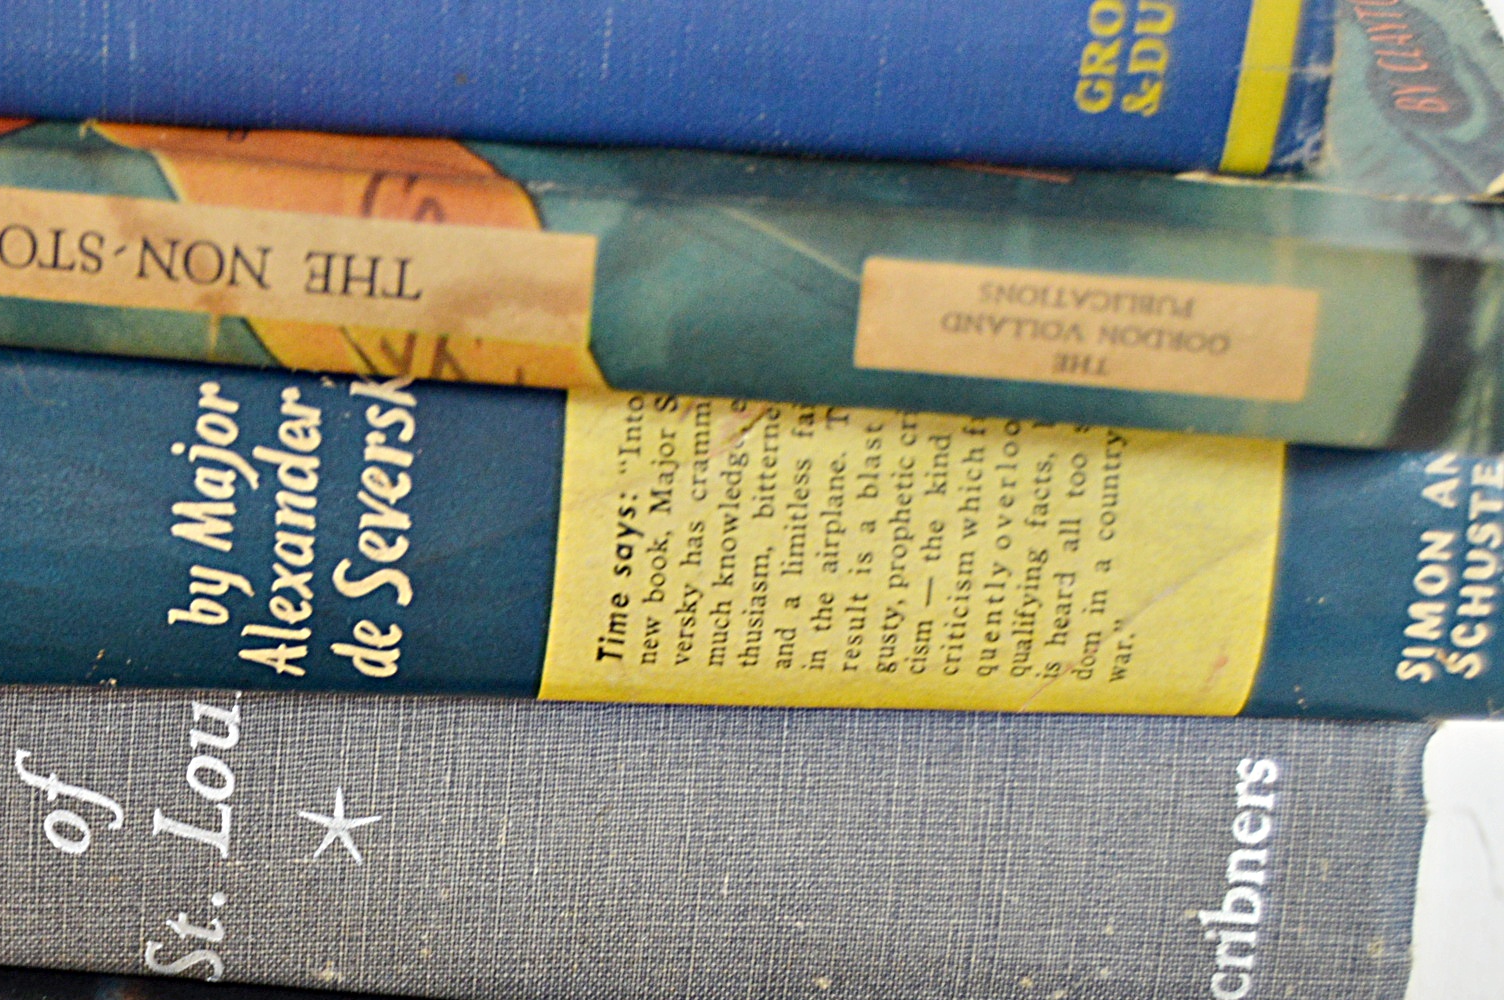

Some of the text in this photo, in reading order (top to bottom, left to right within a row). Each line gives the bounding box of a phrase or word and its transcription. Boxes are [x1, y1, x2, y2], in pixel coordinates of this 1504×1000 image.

[305, 250, 422, 301] THE
[979, 281, 1195, 319] PUBLICATIONS
[940, 311, 1232, 356] GORDON VOLLAND
[1053, 352, 1107, 377] THE
[649, 429, 679, 515] Major
[924, 432, 952, 496] kind
[1024, 451, 1056, 529] facts,
[1066, 452, 1088, 500] too
[167, 381, 260, 625] by Major
[238, 387, 322, 676] Alexander
[596, 396, 644, 662] Time says: “Into
[781, 458, 812, 576] limitless
[816, 452, 848, 574] airplane.
[888, 454, 915, 590] prophetic
[1059, 517, 1082, 553] all
[643, 530, 672, 603] book,
[680, 520, 705, 567] has
[843, 422, 884, 672] result is a blast
[920, 519, 945, 562] the
[940, 549, 975, 676] criticism
[958, 446, 986, 539] which
[976, 420, 1021, 677] quently overloo
[1071, 429, 1128, 680] dom in a country
[674, 583, 704, 666] versky
[708, 600, 732, 667] much
[737, 545, 773, 668] thusiasm,
[785, 595, 801, 609] a
[810, 592, 835, 632] the
[876, 600, 904, 674] gusty,
[1009, 548, 1048, 677] qualifying
[1044, 571, 1077, 647] heard
[1396, 530, 1457, 683] SIMON
[330, 619, 403, 678] de
[640, 616, 661, 665] new
[774, 627, 797, 669] and
[802, 649, 828, 671] in
[904, 618, 933, 675] cism
[1035, 661, 1062, 679] is
[15, 749, 123, 854] of
[144, 891, 227, 982] St.
